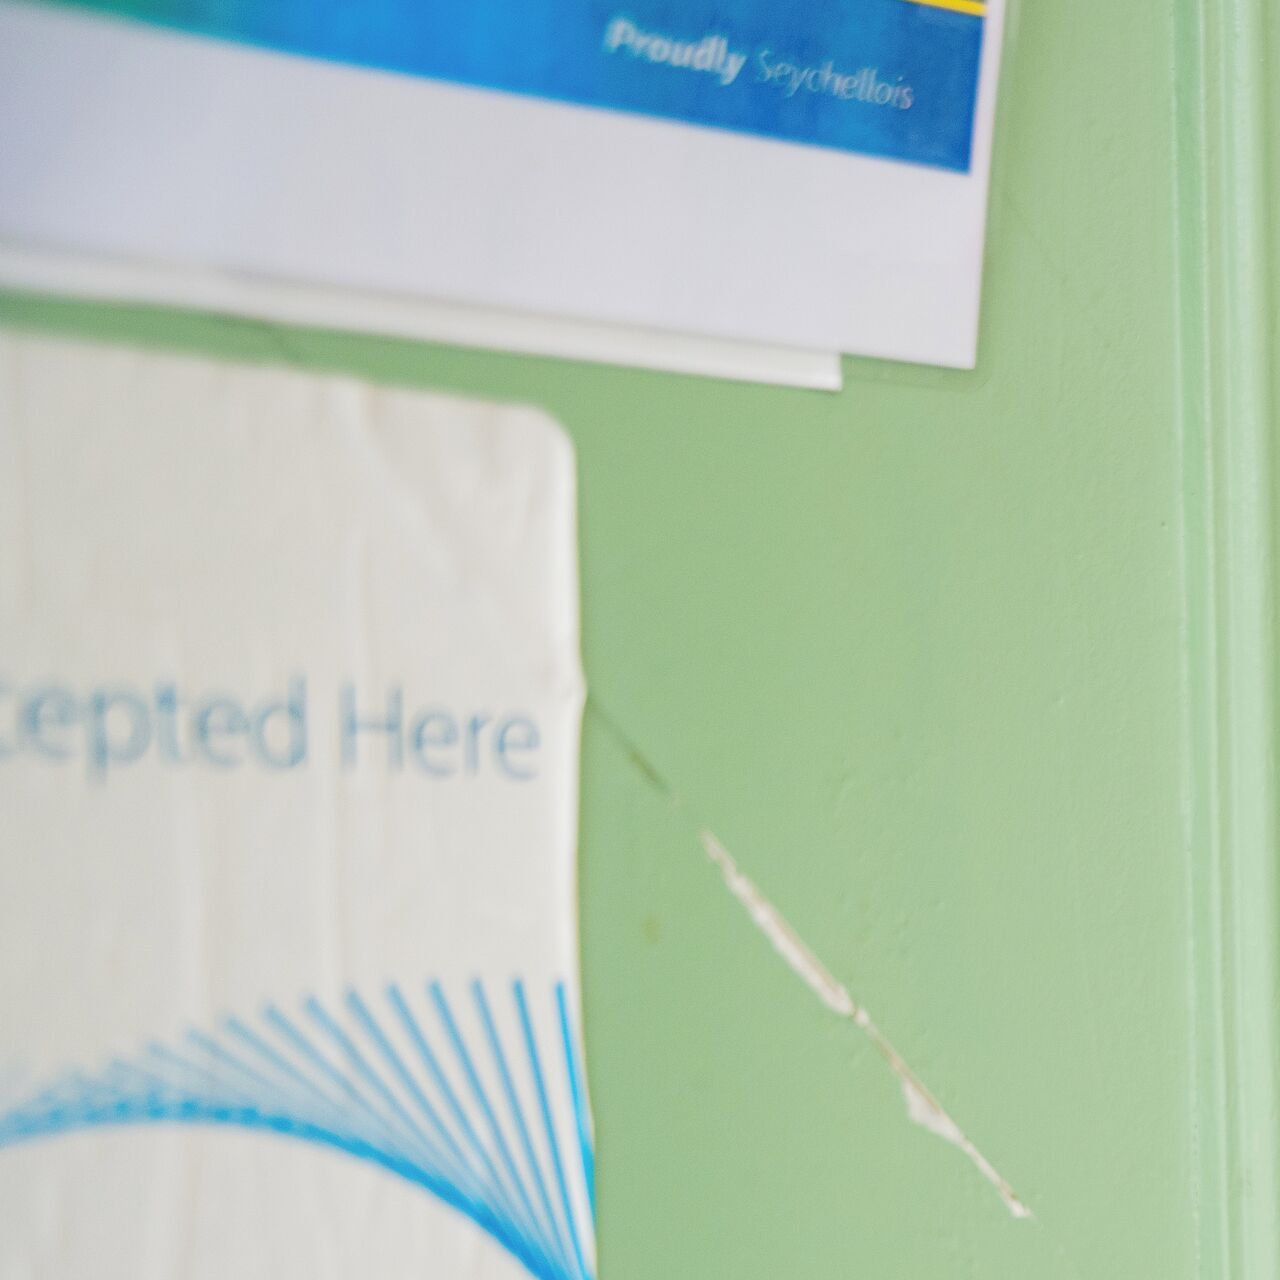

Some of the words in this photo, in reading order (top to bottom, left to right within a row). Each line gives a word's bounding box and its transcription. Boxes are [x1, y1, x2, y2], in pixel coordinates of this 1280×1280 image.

[603, 17, 746, 86] Proudly
[758, 49, 914, 110] Seychellois
[0, 676, 308, 786] epted
[338, 680, 542, 783] Here
